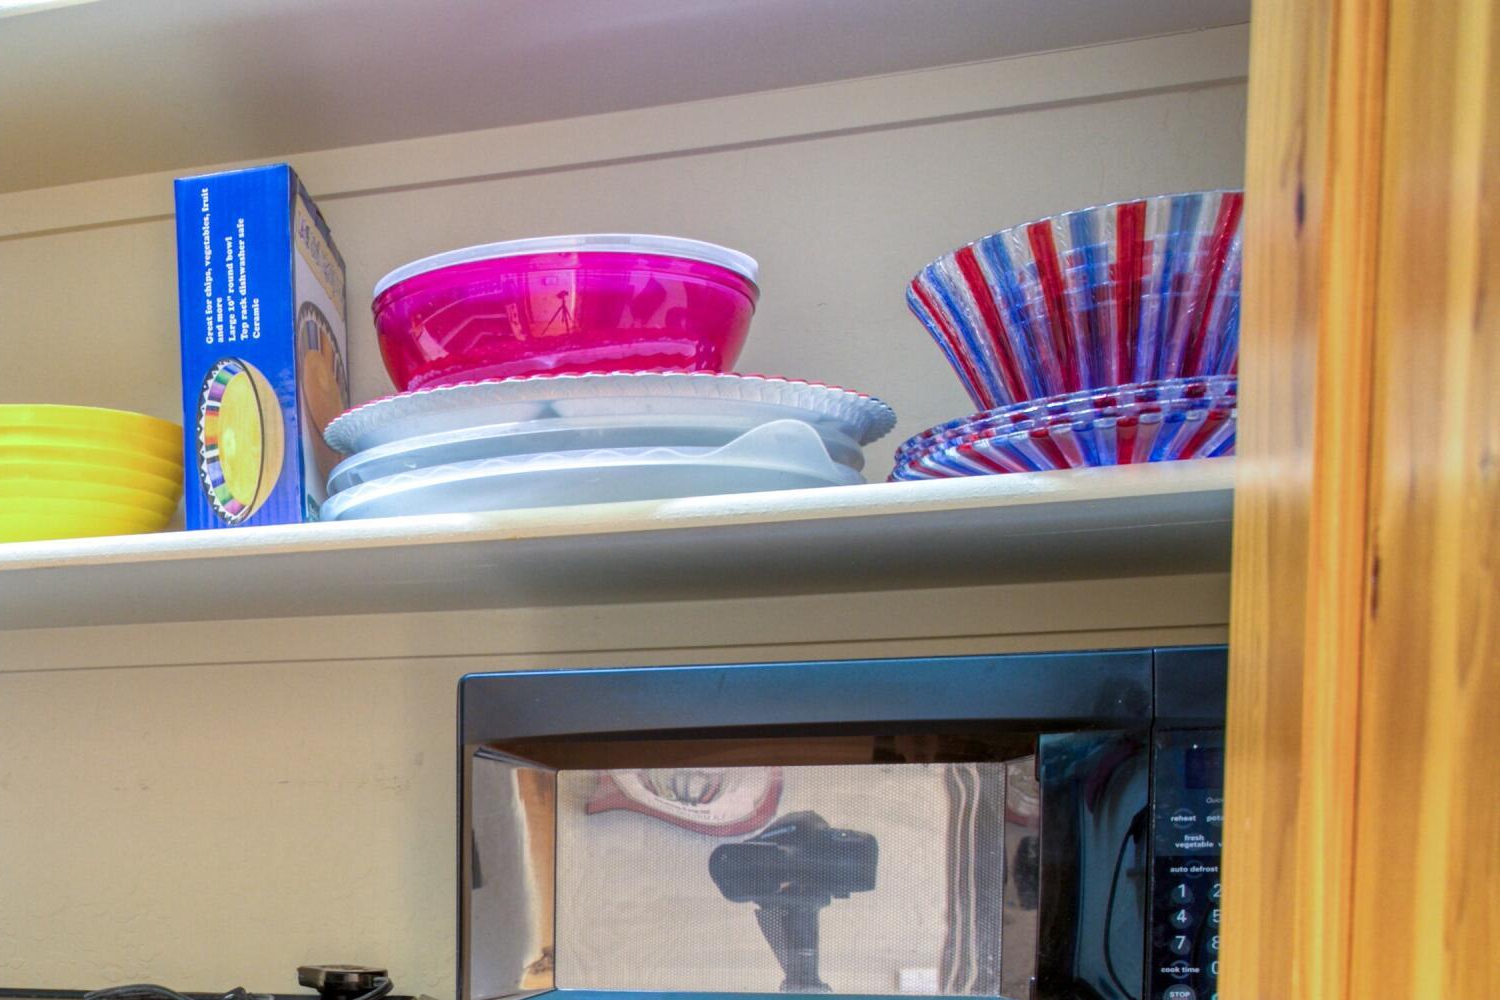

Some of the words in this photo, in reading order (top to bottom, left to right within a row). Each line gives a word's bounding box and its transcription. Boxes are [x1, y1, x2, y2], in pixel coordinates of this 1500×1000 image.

[202, 213, 212, 267] vegetables,
[225, 236, 233, 261] bowl
[226, 262, 234, 293] round
[238, 240, 247, 295] dishwasher
[204, 268, 213, 297] chips,
[216, 297, 224, 321] more
[239, 298, 248, 320] rack
[252, 298, 260, 339] Ceramic
[205, 319, 214, 344] Great
[216, 323, 224, 343] and
[229, 314, 237, 342] Large
[240, 322, 249, 341] Top
[1178, 883, 1186, 898] 1
[1176, 909, 1186, 923] 4
[1175, 936, 1186, 949] 7
